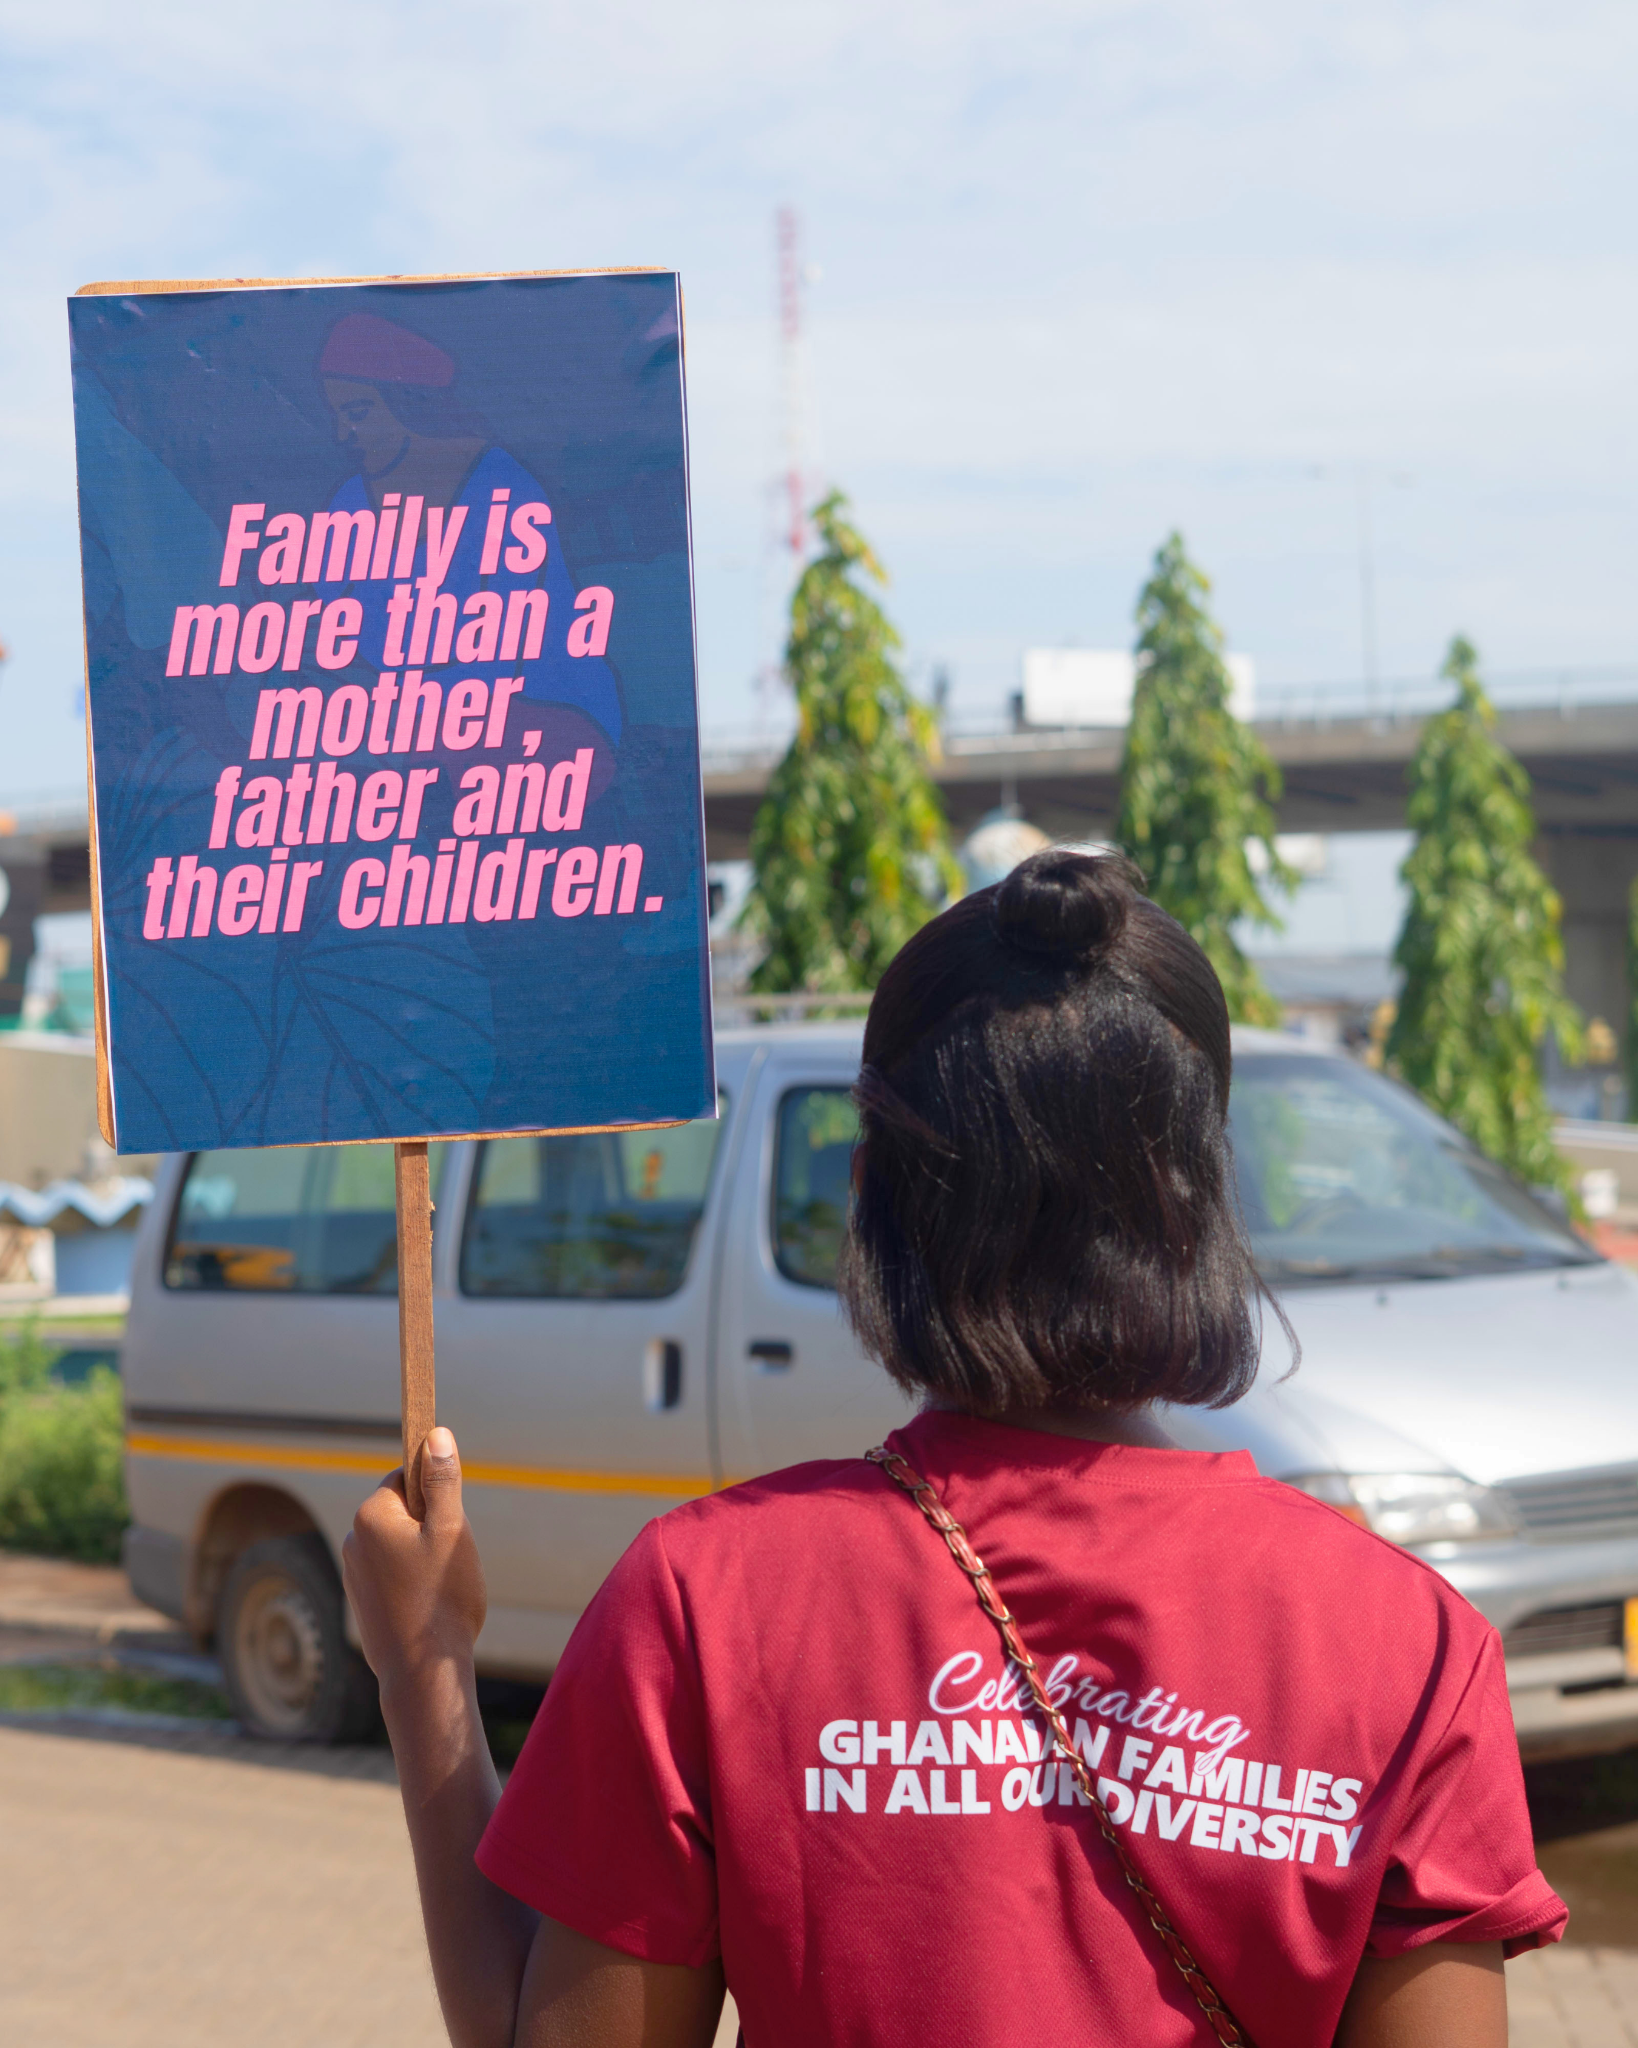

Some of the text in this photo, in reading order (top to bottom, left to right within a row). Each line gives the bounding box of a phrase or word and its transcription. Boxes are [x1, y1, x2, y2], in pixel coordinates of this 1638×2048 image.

[219, 488, 552, 590] Family is
[165, 583, 615, 677] more than a
[248, 669, 543, 760] mother,
[208, 748, 594, 849] father and
[142, 838, 663, 941] their children.
[927, 1650, 1250, 1777] Celebrating
[805, 1761, 1363, 1867] IN ALL OUR DIVERSITY
[818, 1715, 1363, 1821] GHANAIAN FAMILIES
